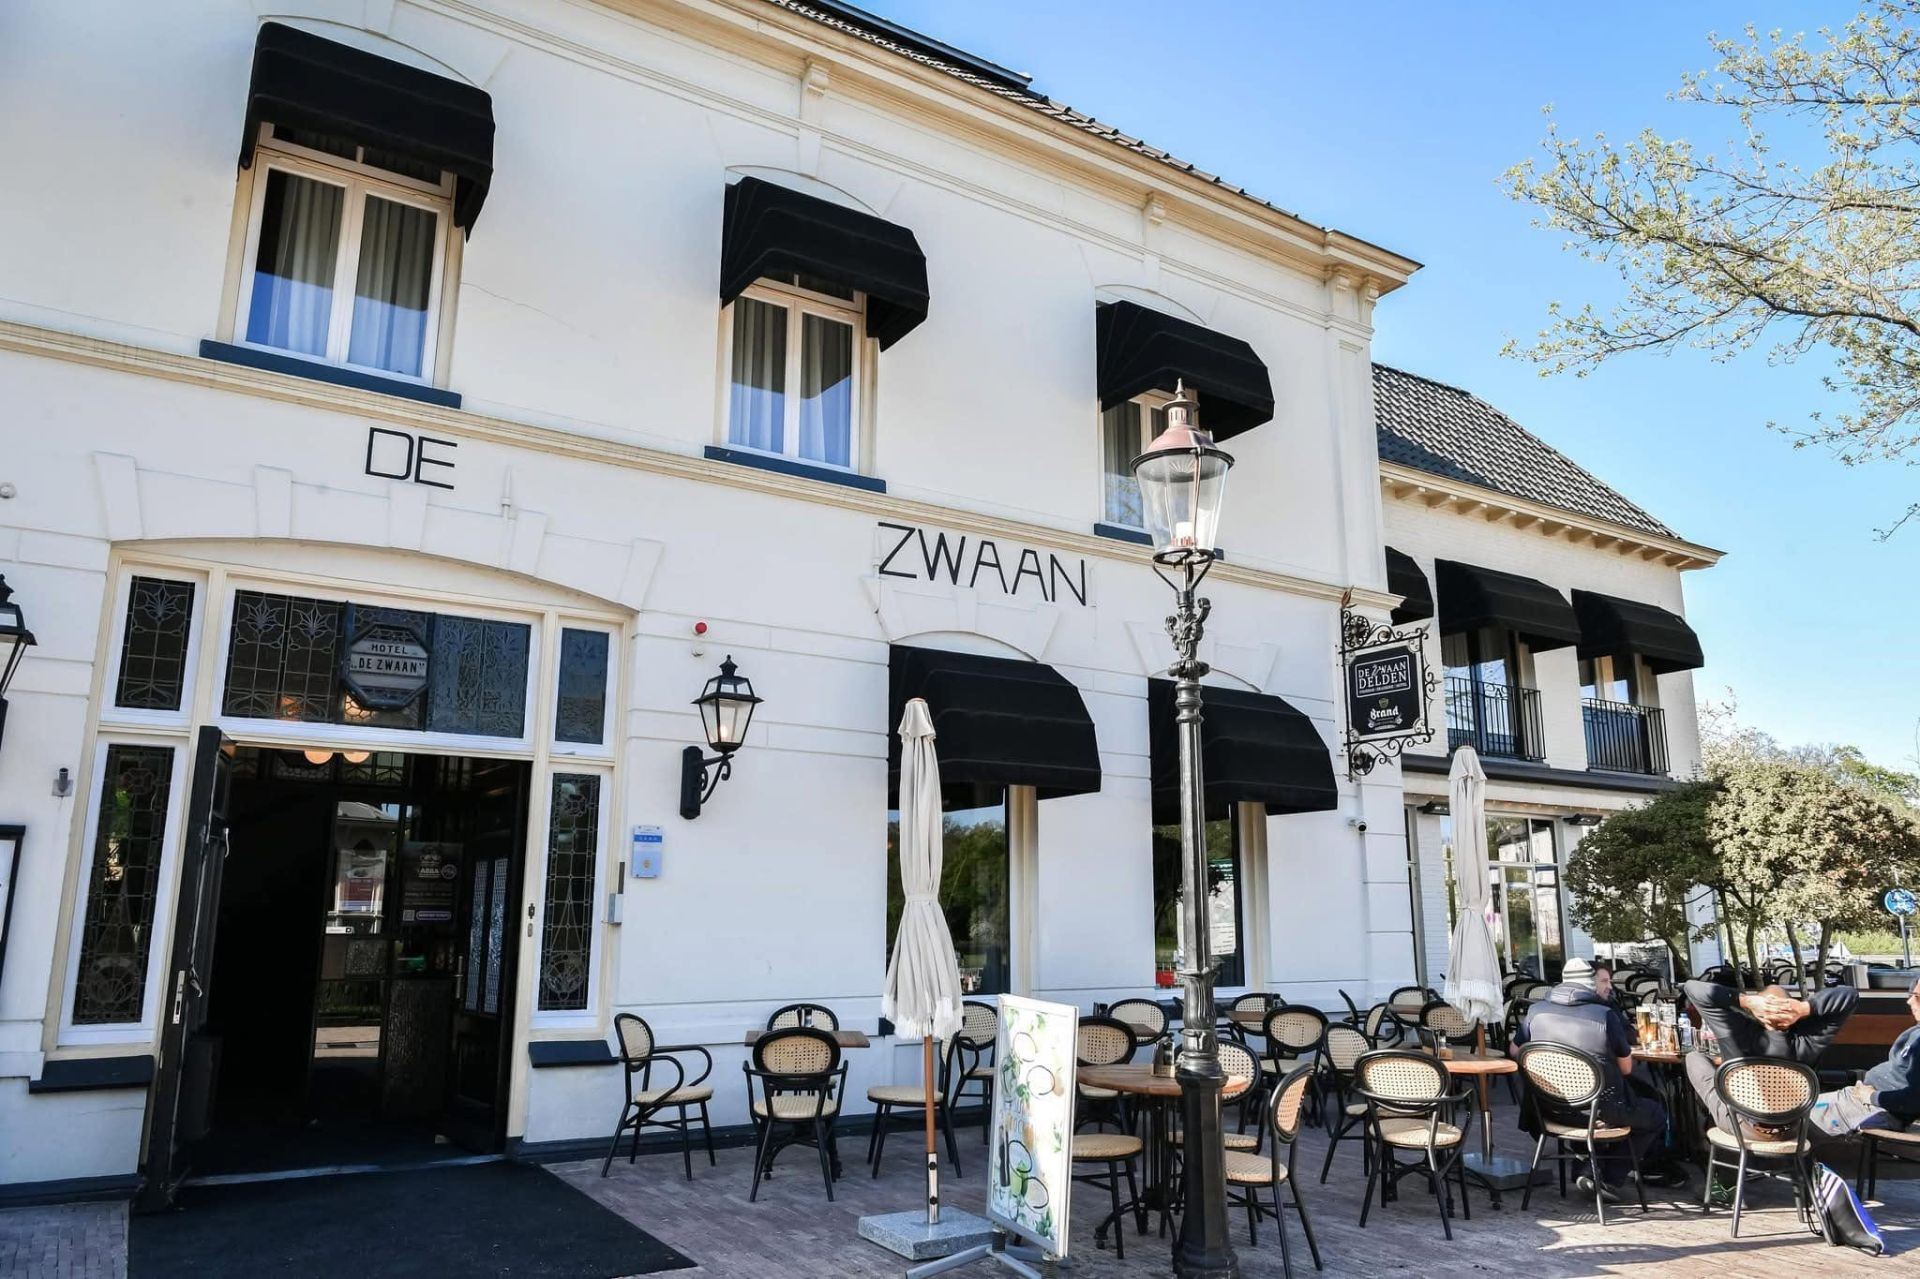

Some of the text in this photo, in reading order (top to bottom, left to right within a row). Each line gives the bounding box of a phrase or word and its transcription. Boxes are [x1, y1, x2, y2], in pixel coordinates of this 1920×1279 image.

[365, 427, 1086, 606] DE ZWAAN
[371, 643, 408, 655] HOTEL
[1358, 661, 1406, 678] DE ZWAAN
[1359, 670, 1407, 689] DELDEN
[1370, 705, 1399, 720] Brand
